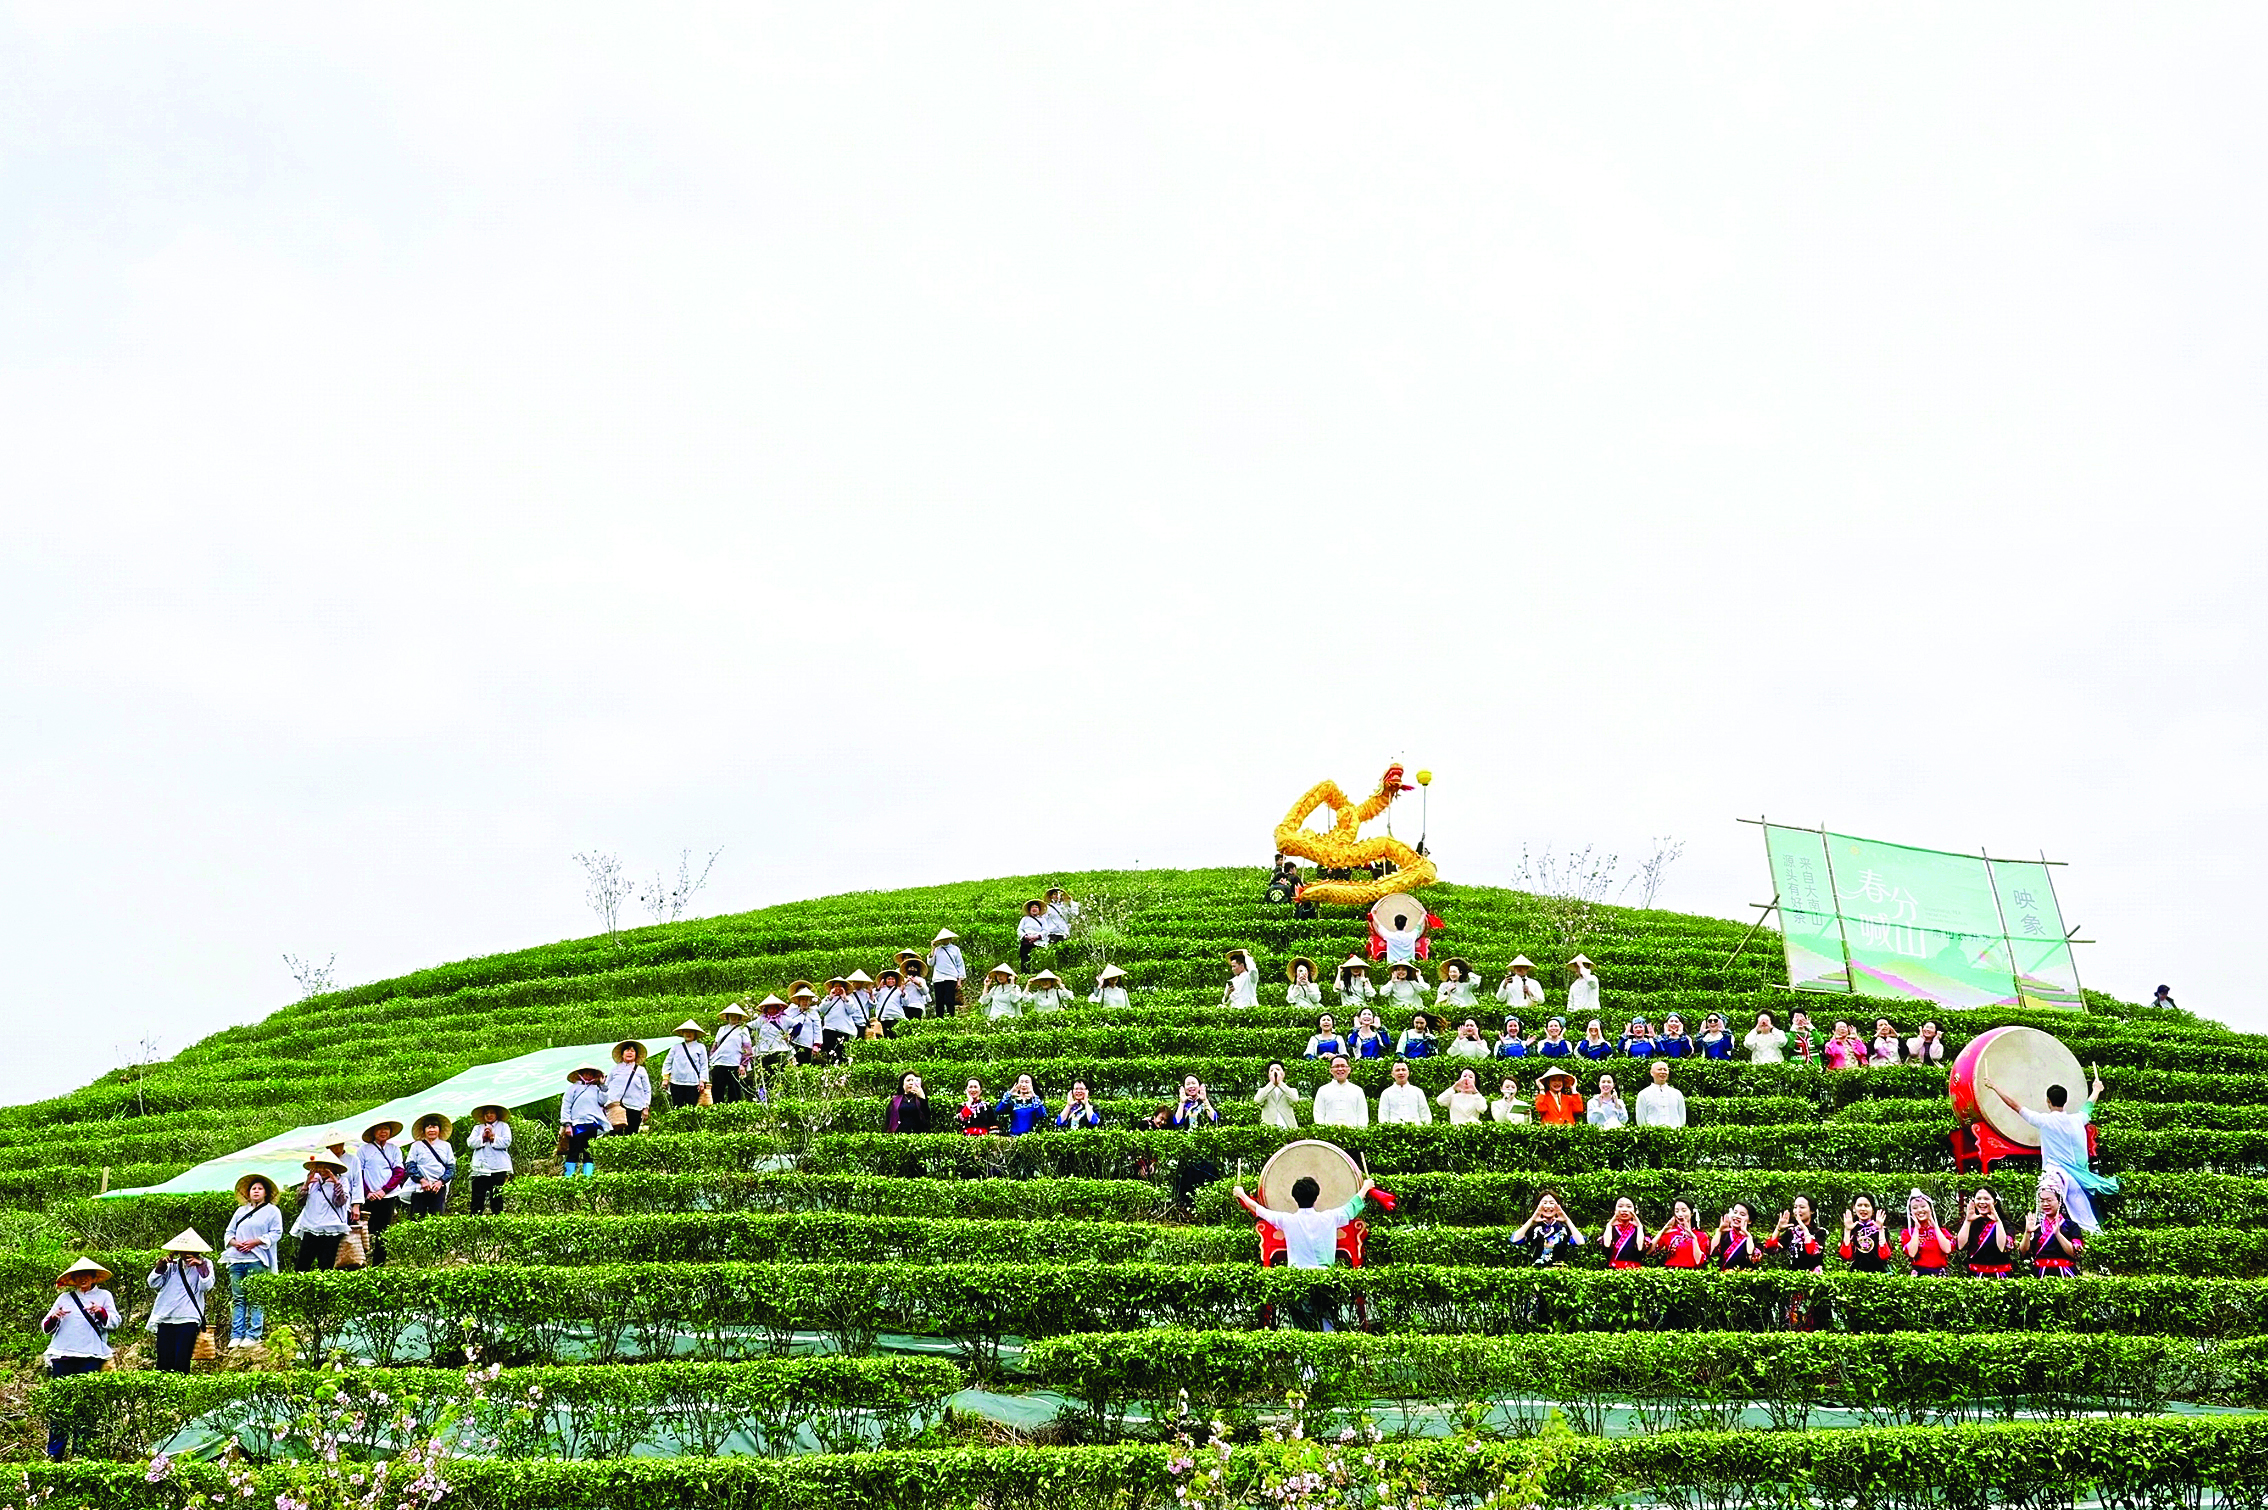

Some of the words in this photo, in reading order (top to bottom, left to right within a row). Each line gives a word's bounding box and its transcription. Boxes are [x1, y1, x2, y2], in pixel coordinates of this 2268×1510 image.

[1799, 856, 1823, 926] 来自大南山
[1858, 868, 1918, 921] 春分
[2013, 888, 2046, 936] 映象
[1858, 912, 1927, 959] 喊山
